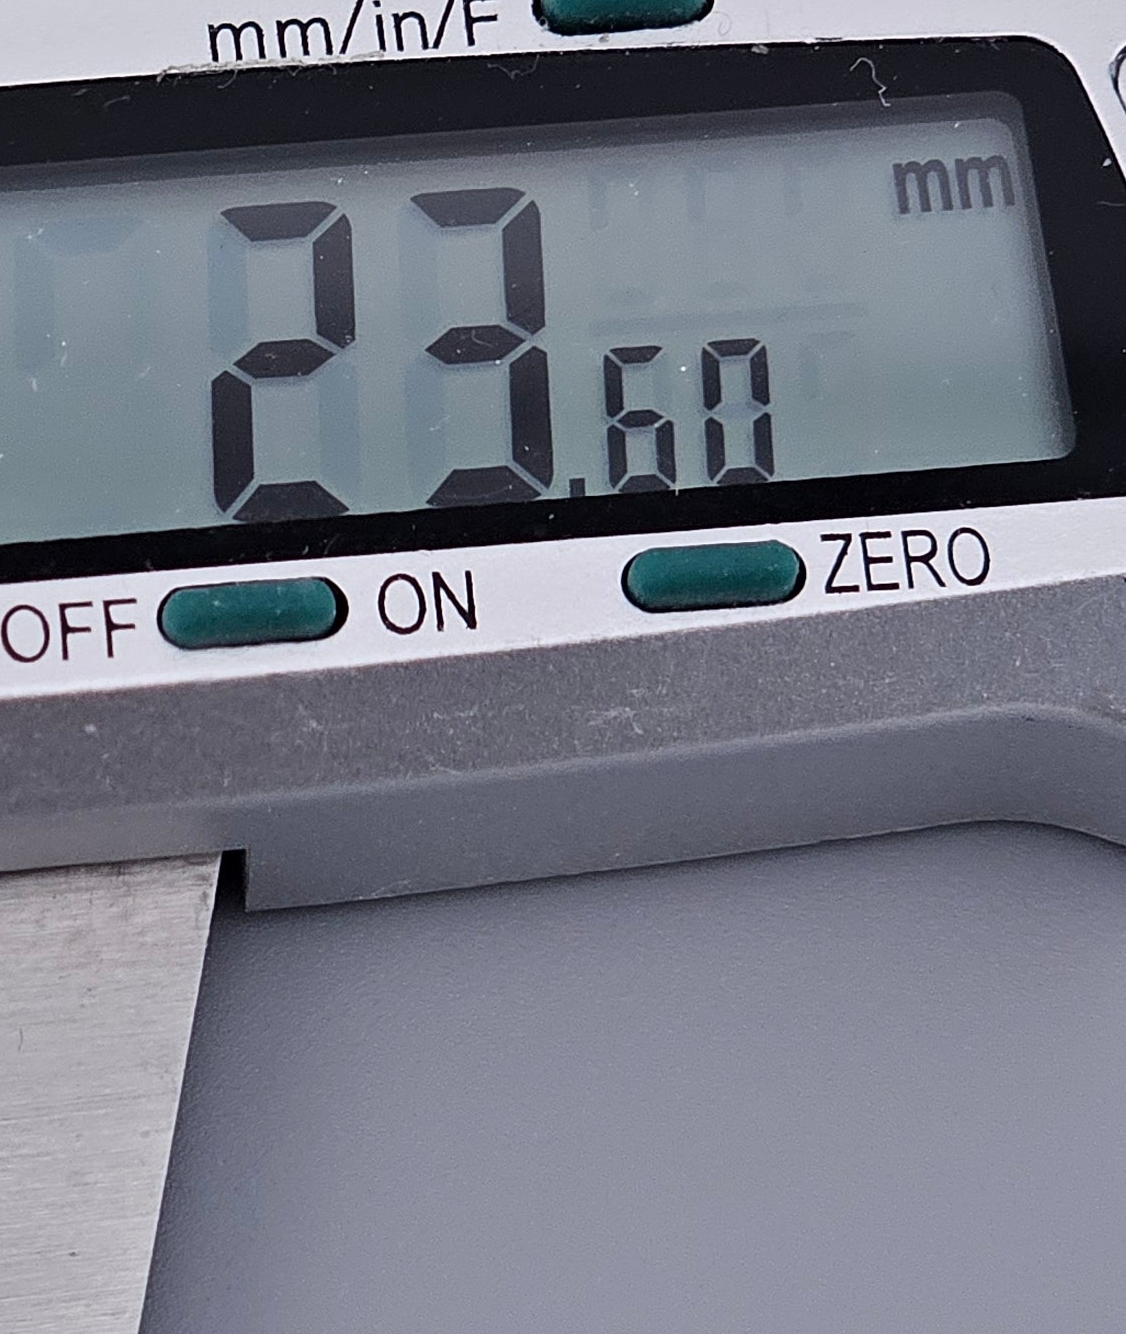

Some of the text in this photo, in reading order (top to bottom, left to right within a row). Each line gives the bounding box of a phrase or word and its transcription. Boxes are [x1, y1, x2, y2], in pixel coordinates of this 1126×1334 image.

[892, 151, 1017, 219] mm
[210, 186, 775, 523] 23.60
[819, 526, 992, 596] ZERO
[0, 570, 478, 663] OFF ON
